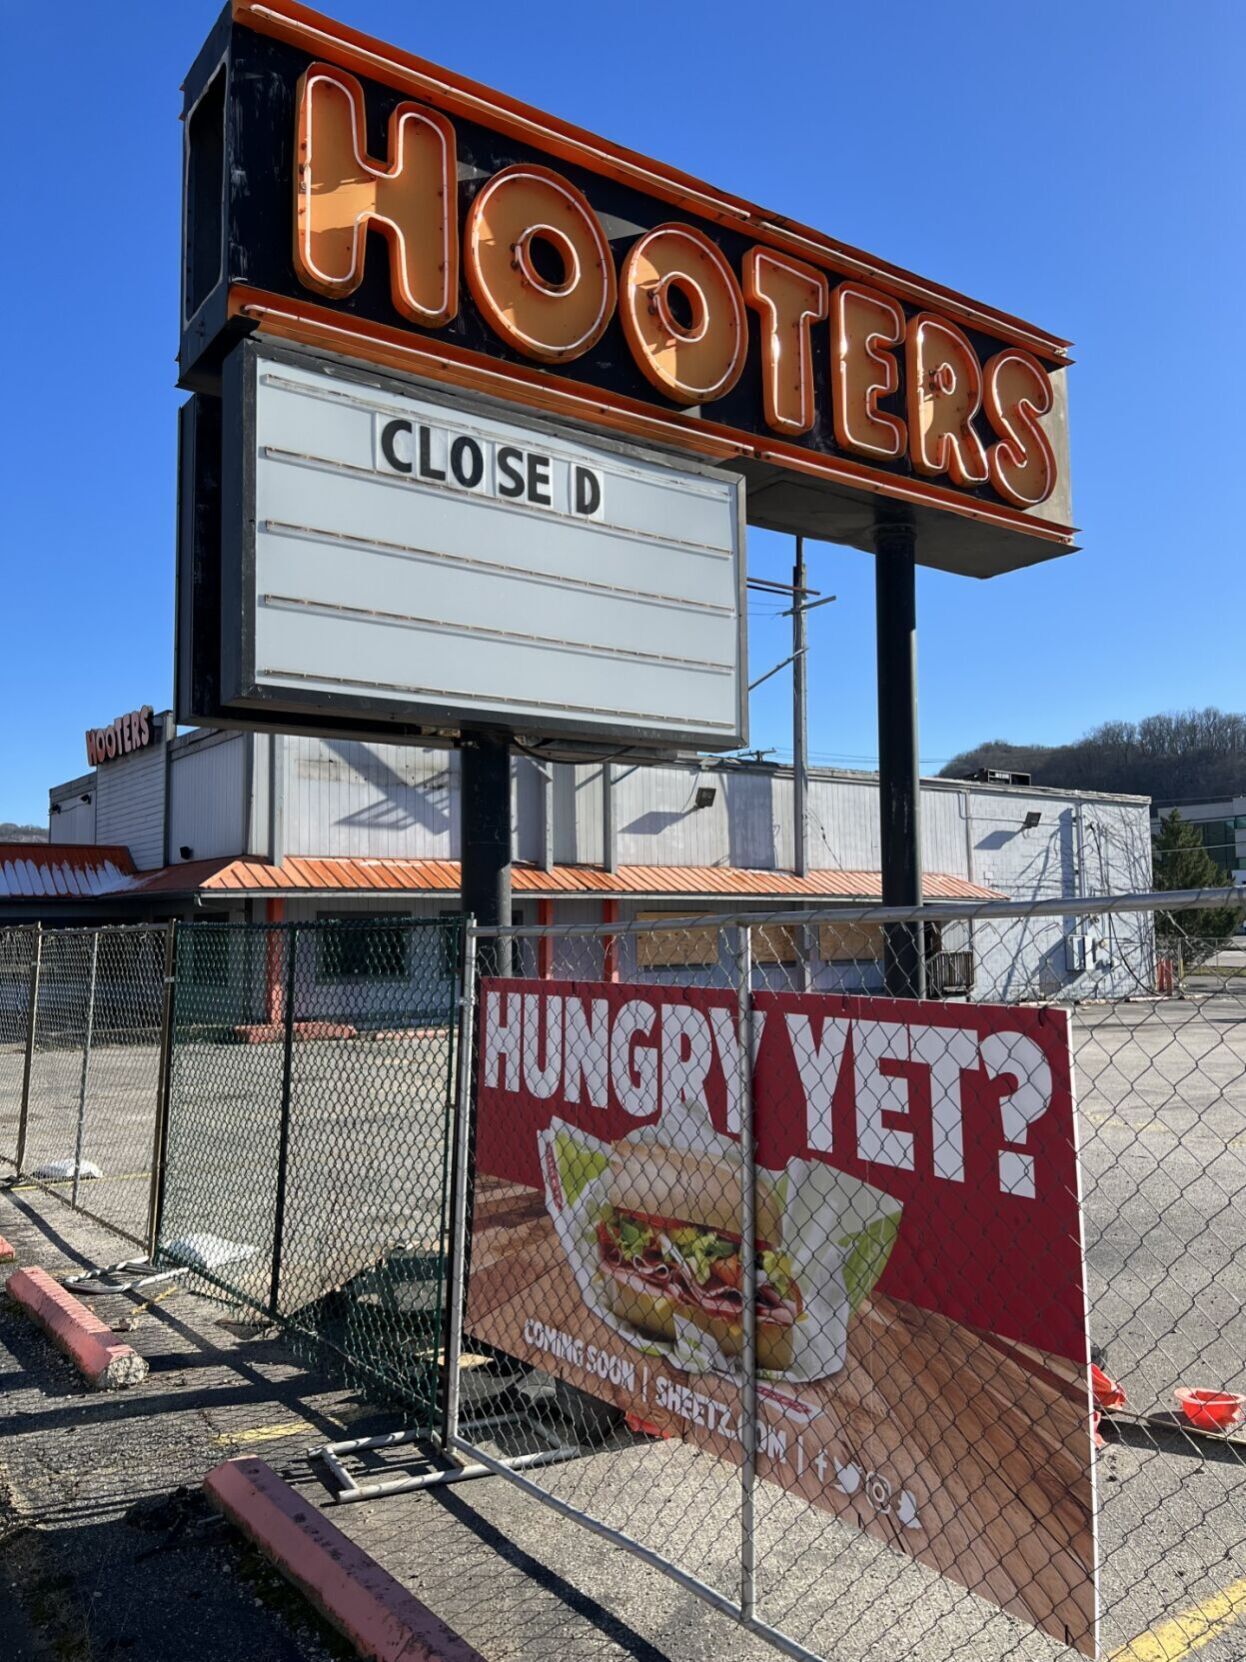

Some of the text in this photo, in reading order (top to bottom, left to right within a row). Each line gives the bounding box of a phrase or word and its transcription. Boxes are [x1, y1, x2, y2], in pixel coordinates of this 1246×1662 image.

[294, 61, 1058, 508] HOOTERS
[86, 705, 153, 766] HOOTERS
[484, 990, 1052, 1199] HUNGRY YET?
[524, 1318, 584, 1367] COMING
[586, 1344, 635, 1392] SOON
